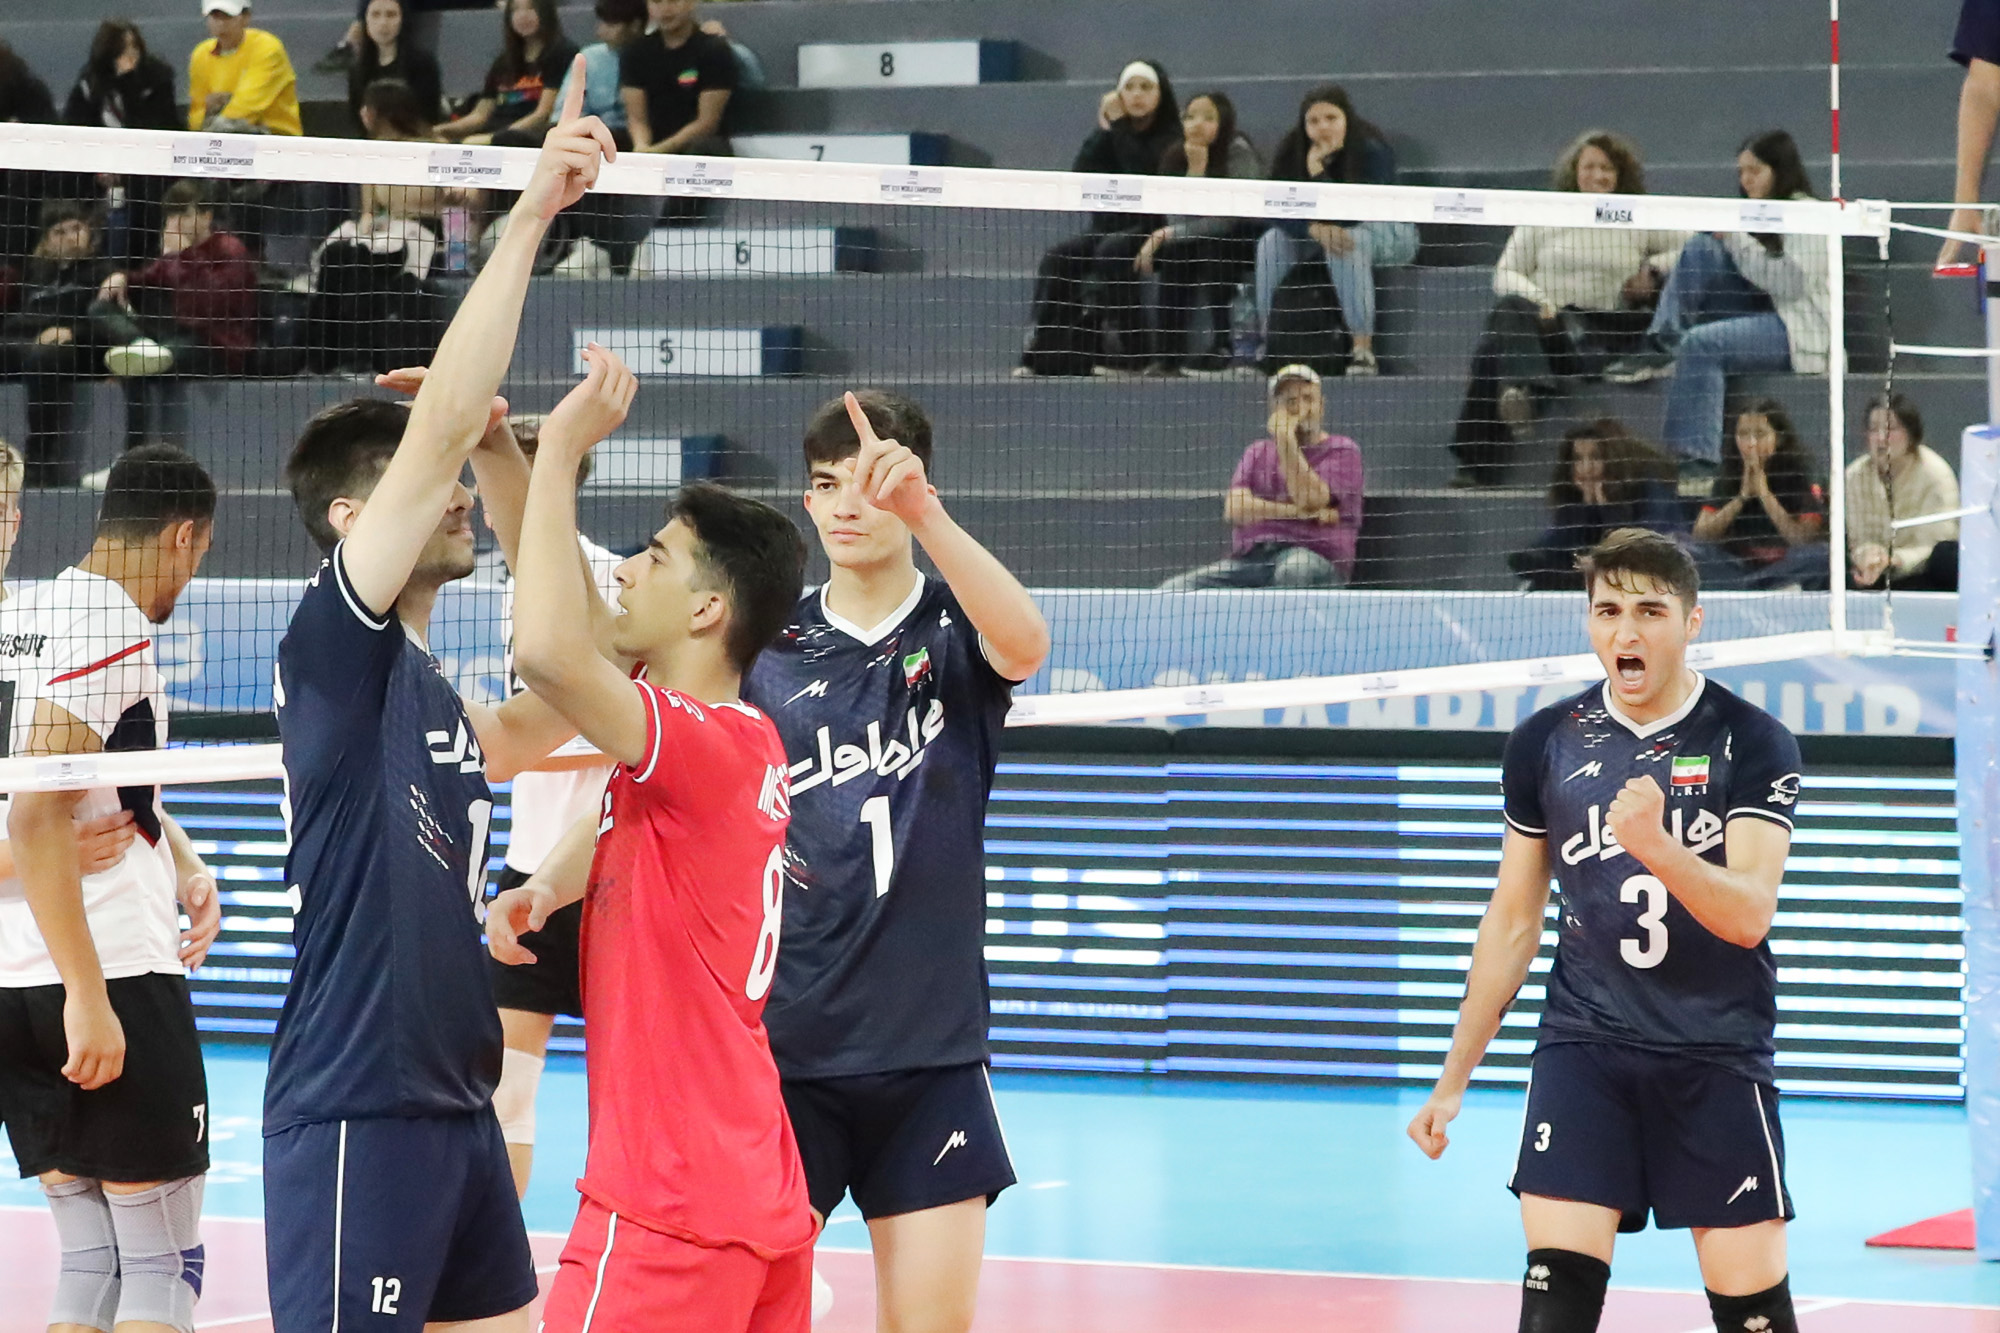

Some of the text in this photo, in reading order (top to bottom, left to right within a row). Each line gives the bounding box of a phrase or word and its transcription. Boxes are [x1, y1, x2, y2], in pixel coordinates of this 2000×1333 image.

[879, 51, 895, 78] 8
[809, 144, 825, 162] 7
[1595, 207, 1634, 223] MIKASA
[736, 240, 749, 264] 6
[660, 338, 673, 364] 5
[859, 795, 895, 899] 1
[745, 843, 785, 1001] 8
[1619, 874, 1669, 969] 3
[192, 1103, 205, 1143] 7
[1534, 1122, 1552, 1152] 3
[371, 1276, 402, 1315] 12
